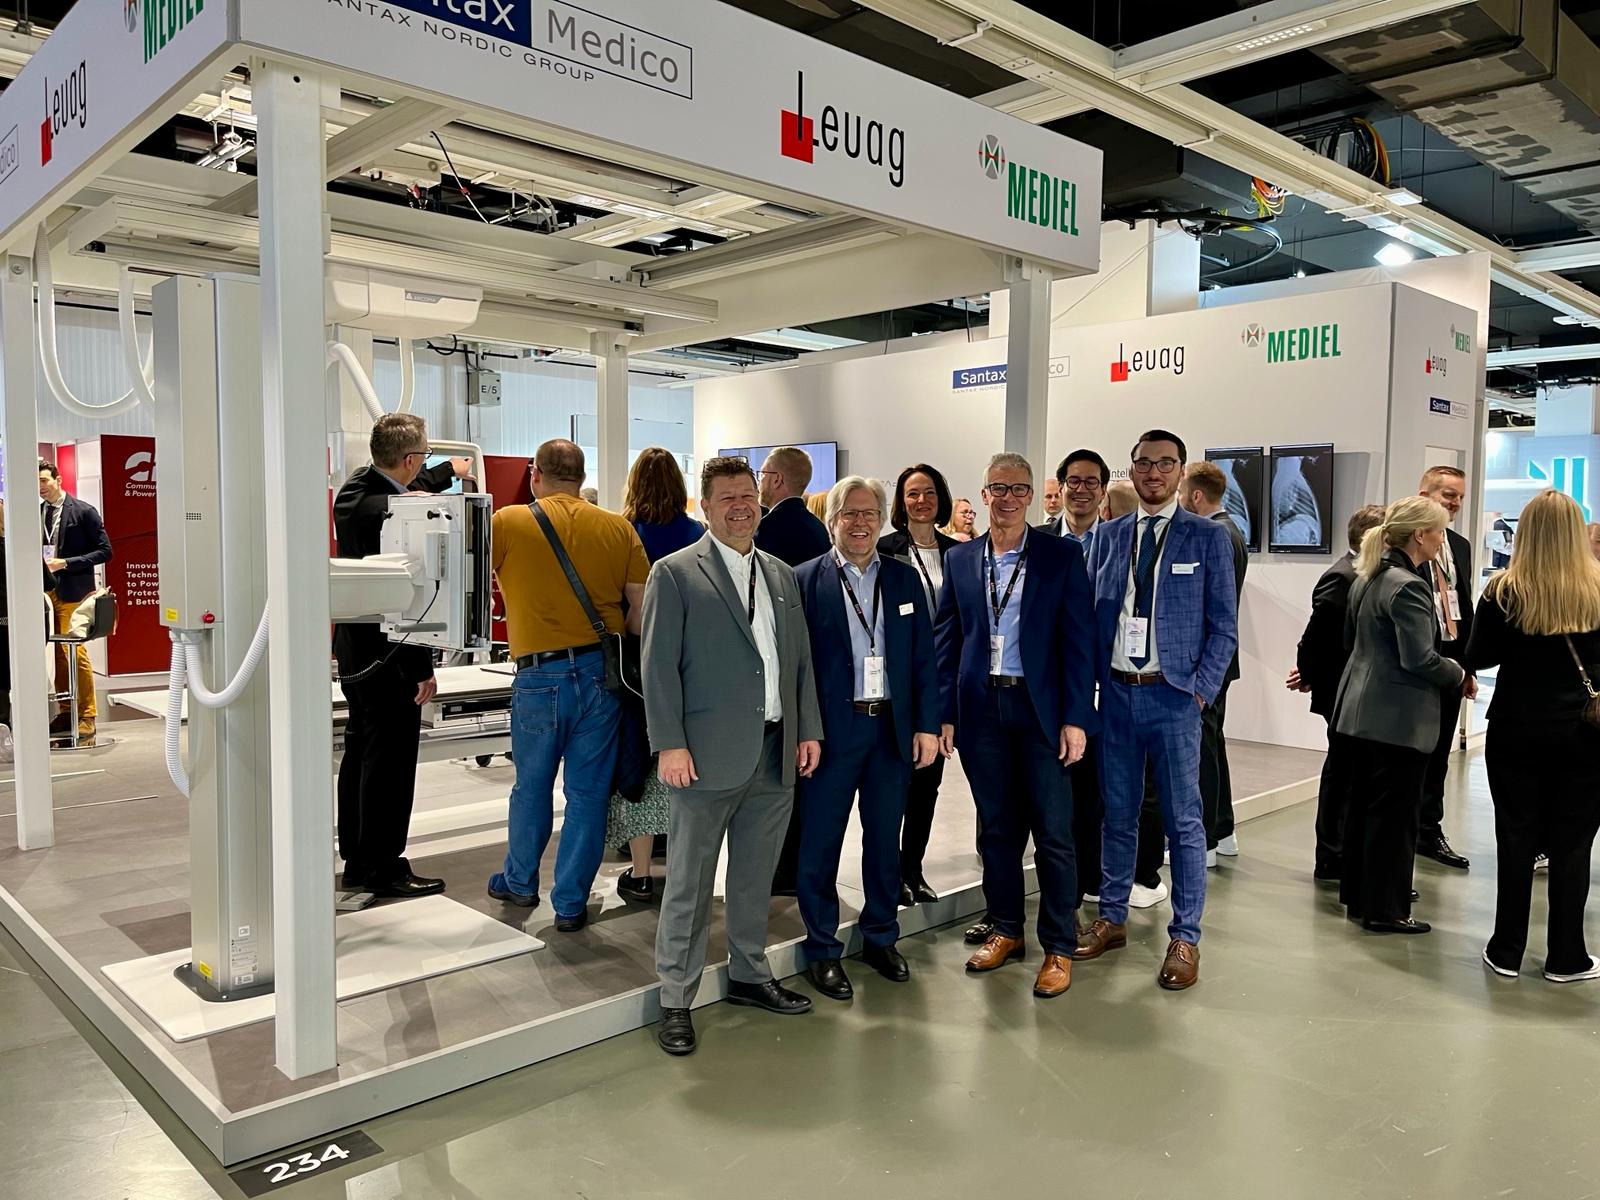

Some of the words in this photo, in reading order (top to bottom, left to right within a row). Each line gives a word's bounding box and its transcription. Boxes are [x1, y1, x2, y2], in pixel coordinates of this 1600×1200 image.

[424, 21, 512, 58] NORDIC
[524, 52, 595, 82] GROUP
[547, 8, 679, 83] Medico
[44, 60, 87, 146] Leuag
[796, 70, 905, 188] Leuag
[1007, 161, 1079, 236] MEDIEL
[1119, 342, 1185, 375] Leuag
[1267, 323, 1341, 364] MEDIEL
[960, 370, 1007, 385] Santax
[125, 482, 157, 490] Commu
[132, 490, 156, 498] Power
[263, 1143, 350, 1184] 234
